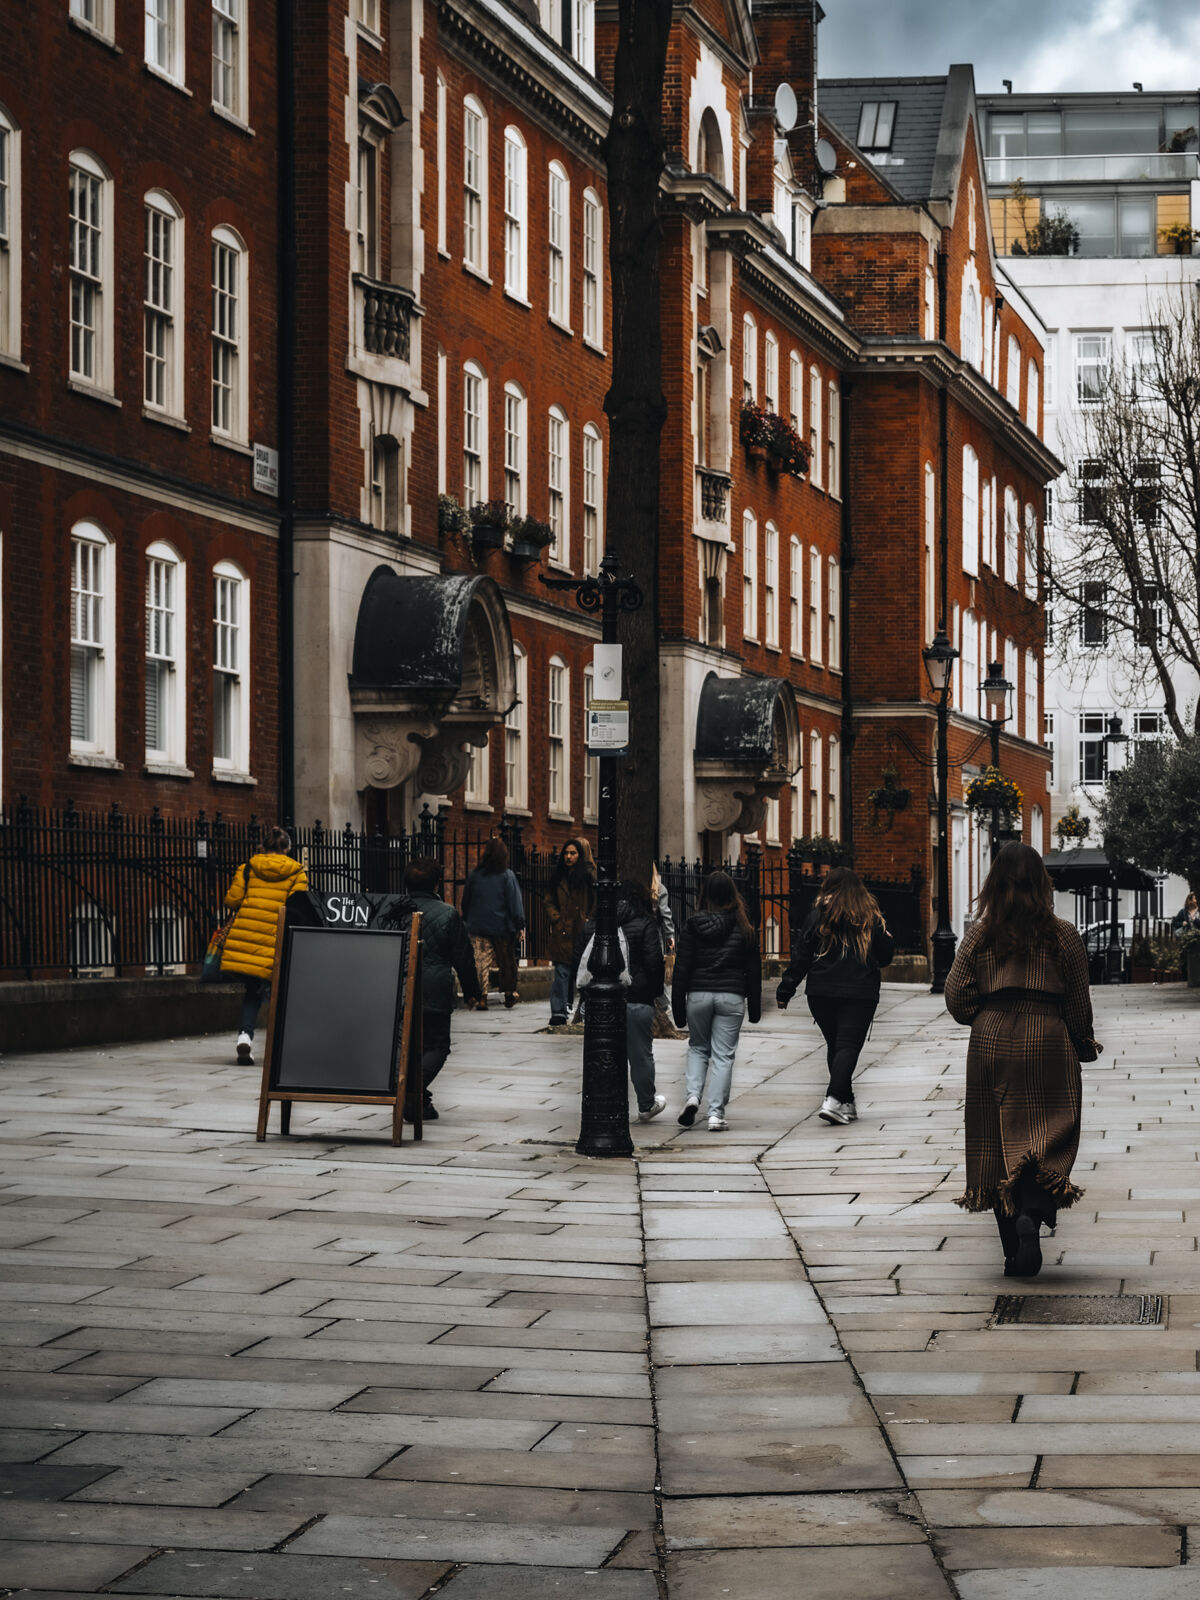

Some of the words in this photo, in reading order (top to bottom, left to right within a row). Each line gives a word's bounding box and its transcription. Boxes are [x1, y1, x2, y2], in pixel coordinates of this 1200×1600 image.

[602, 786, 610, 798] 2
[342, 897, 354, 905] THE
[326, 897, 369, 922] SUN
